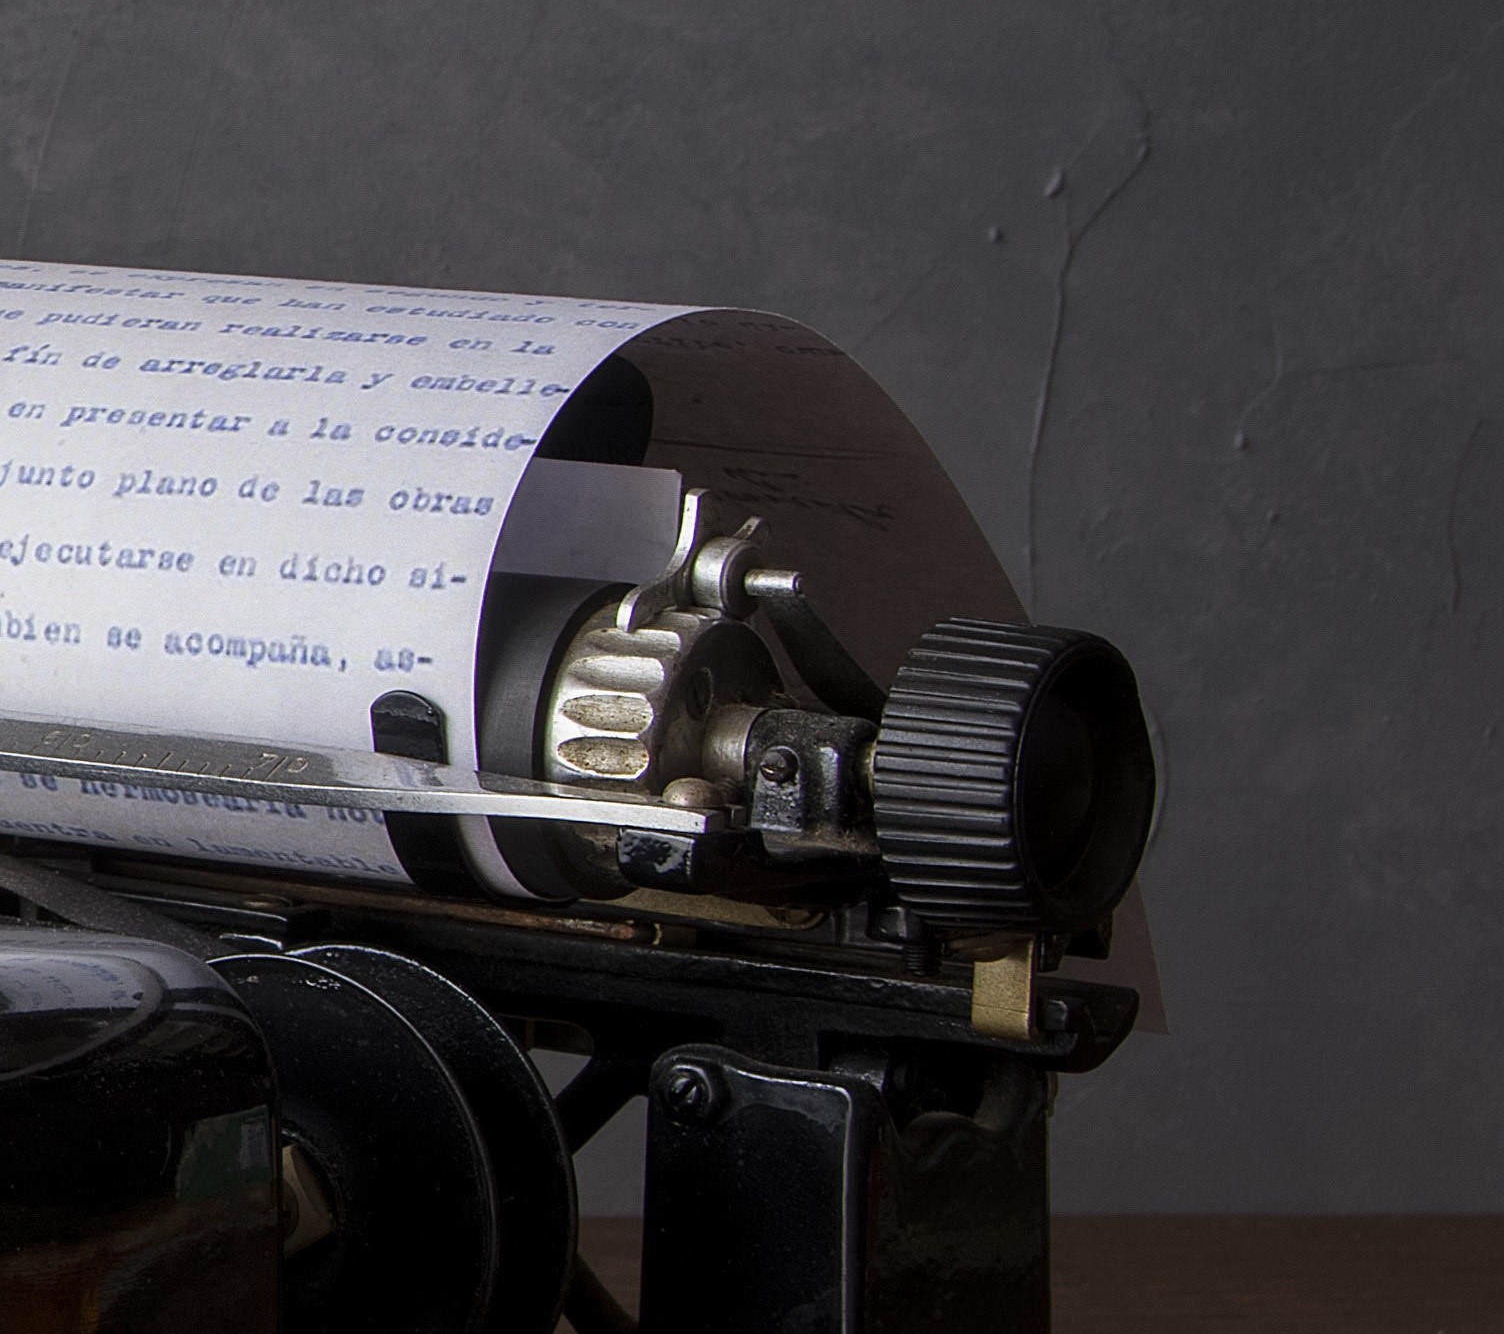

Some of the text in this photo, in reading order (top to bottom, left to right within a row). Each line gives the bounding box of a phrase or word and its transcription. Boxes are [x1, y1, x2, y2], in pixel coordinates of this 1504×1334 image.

[34, 311, 203, 332] pudieran
[217, 322, 429, 347] realizarse
[448, 337, 494, 351] en
[510, 339, 556, 356] la
[201, 294, 263, 306] que
[277, 297, 347, 312] han
[365, 304, 557, 324] estudiado
[574, 319, 639, 331] con
[80, 351, 123, 371] de
[137, 358, 348, 386] arreglarla
[359, 372, 395, 391] y
[409, 373, 571, 398] embelle-
[6, 400, 47, 420] en
[58, 405, 253, 434] presentar
[266, 418, 291, 438] a
[308, 416, 353, 442] la
[373, 424, 537, 451] conside-
[111, 468, 219, 500] plano
[236, 473, 281, 504] de
[301, 478, 366, 509] las
[387, 485, 496, 517] obras
[217, 553, 258, 578] en
[278, 551, 388, 587] dicho
[407, 561, 469, 592] si-
[106, 625, 143, 652] se
[163, 631, 349, 674] acompaña,
[373, 647, 435, 673] as-
[131, 832, 171, 847] en
[184, 836, 400, 875] lamentable
